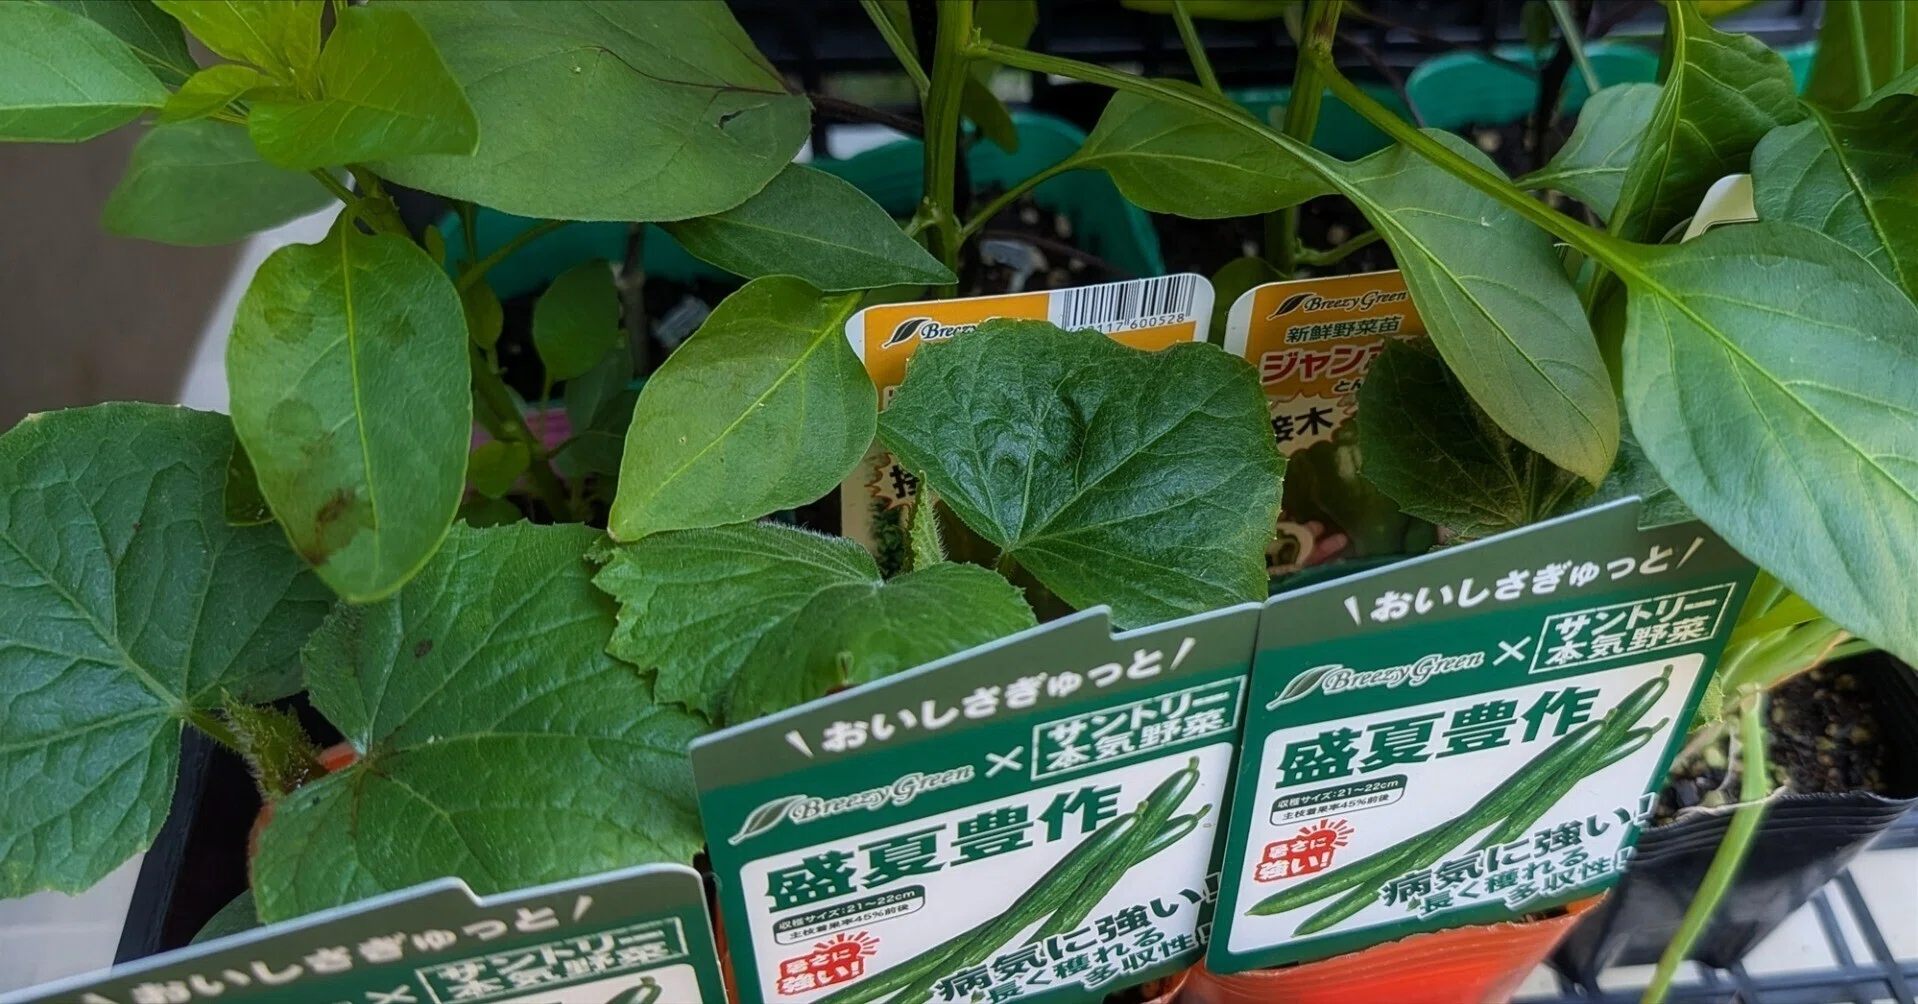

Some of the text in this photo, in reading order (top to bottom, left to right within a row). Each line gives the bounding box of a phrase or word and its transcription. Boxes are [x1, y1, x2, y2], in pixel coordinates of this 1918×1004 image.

[1130, 313, 1185, 329] 600528
[1286, 316, 1402, 342] 新鮮野菜苗
[1371, 544, 1670, 624] おいしさぎゅっと
[1544, 615, 1711, 664] 本気野菜
[1555, 596, 1718, 641] サントリー
[821, 647, 1164, 753] おいしさぎゅっと
[1047, 691, 1230, 747] サントリー
[1046, 707, 1227, 771] 本気野菜
[1275, 688, 1602, 790] 盛夏豊作
[764, 784, 1123, 913] 盛夏豊作
